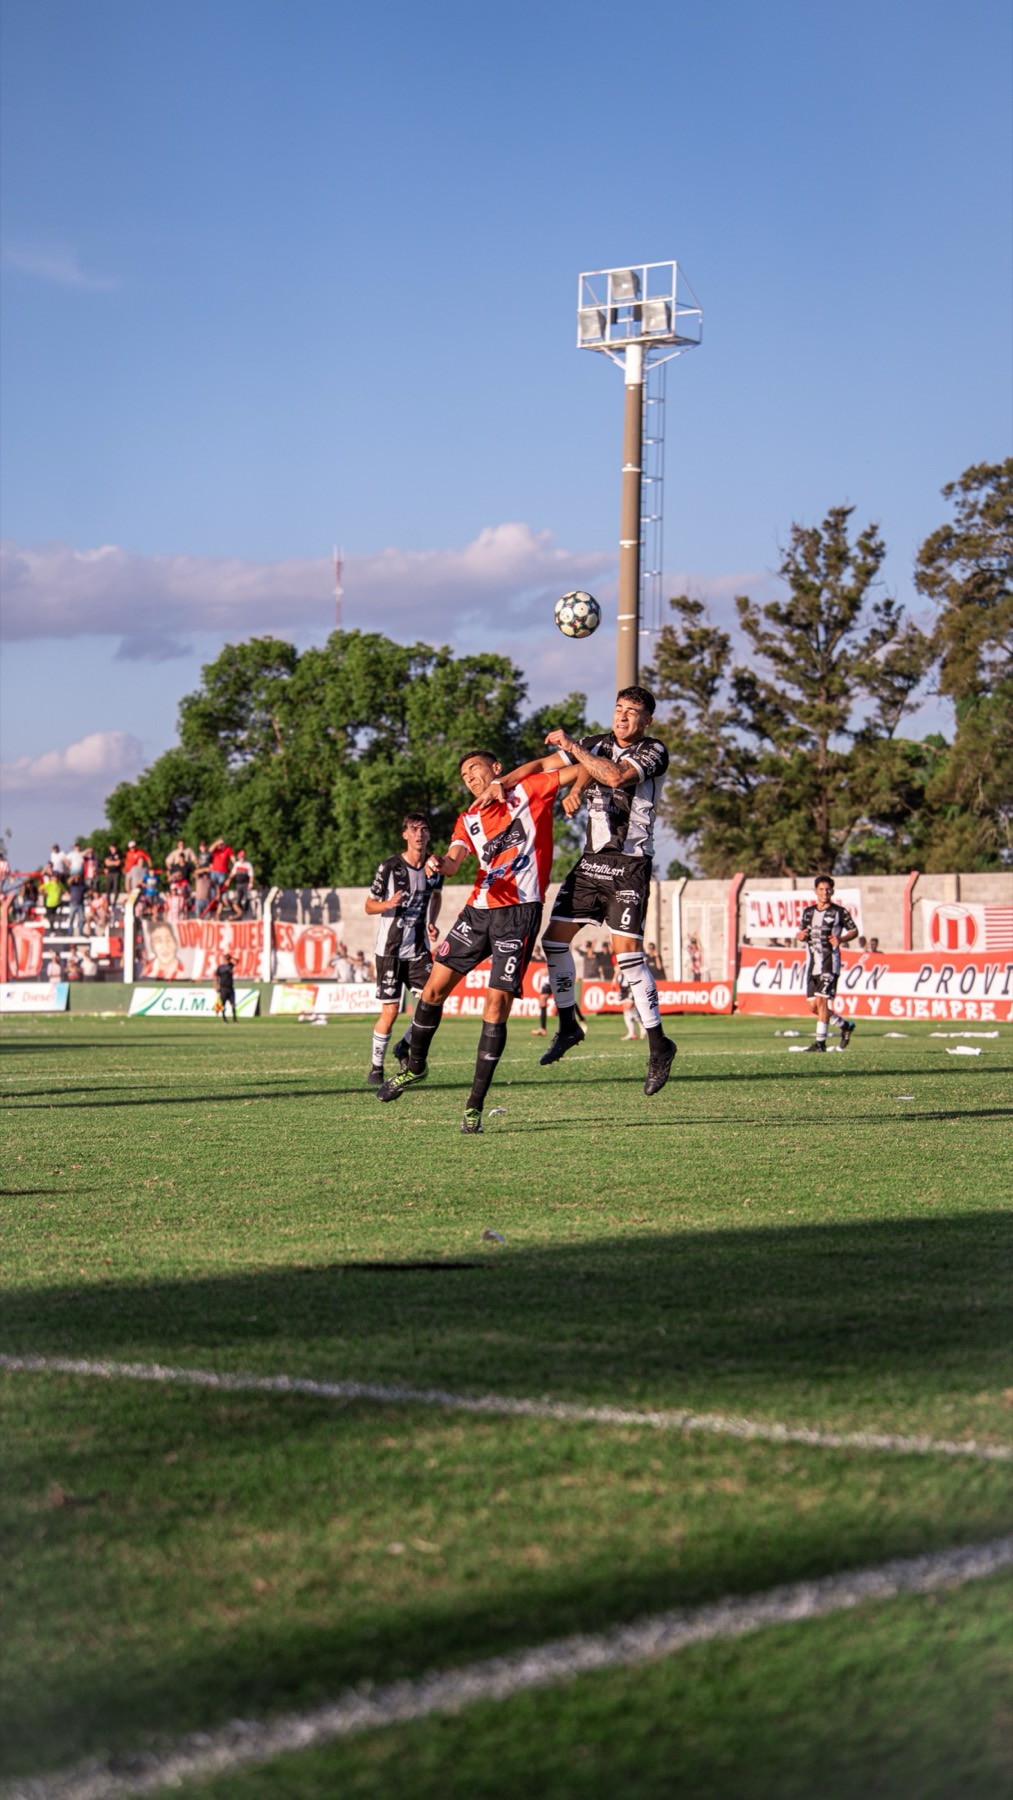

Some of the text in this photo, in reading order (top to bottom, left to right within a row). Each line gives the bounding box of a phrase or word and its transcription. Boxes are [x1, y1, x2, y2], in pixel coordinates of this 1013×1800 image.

[470, 822, 480, 836] 6
[620, 907, 631, 925] 6
[177, 921, 225, 951] DONDE
[504, 955, 517, 974] 6
[867, 996, 880, 1015] Y
[889, 997, 997, 1021] SIEMPRE
